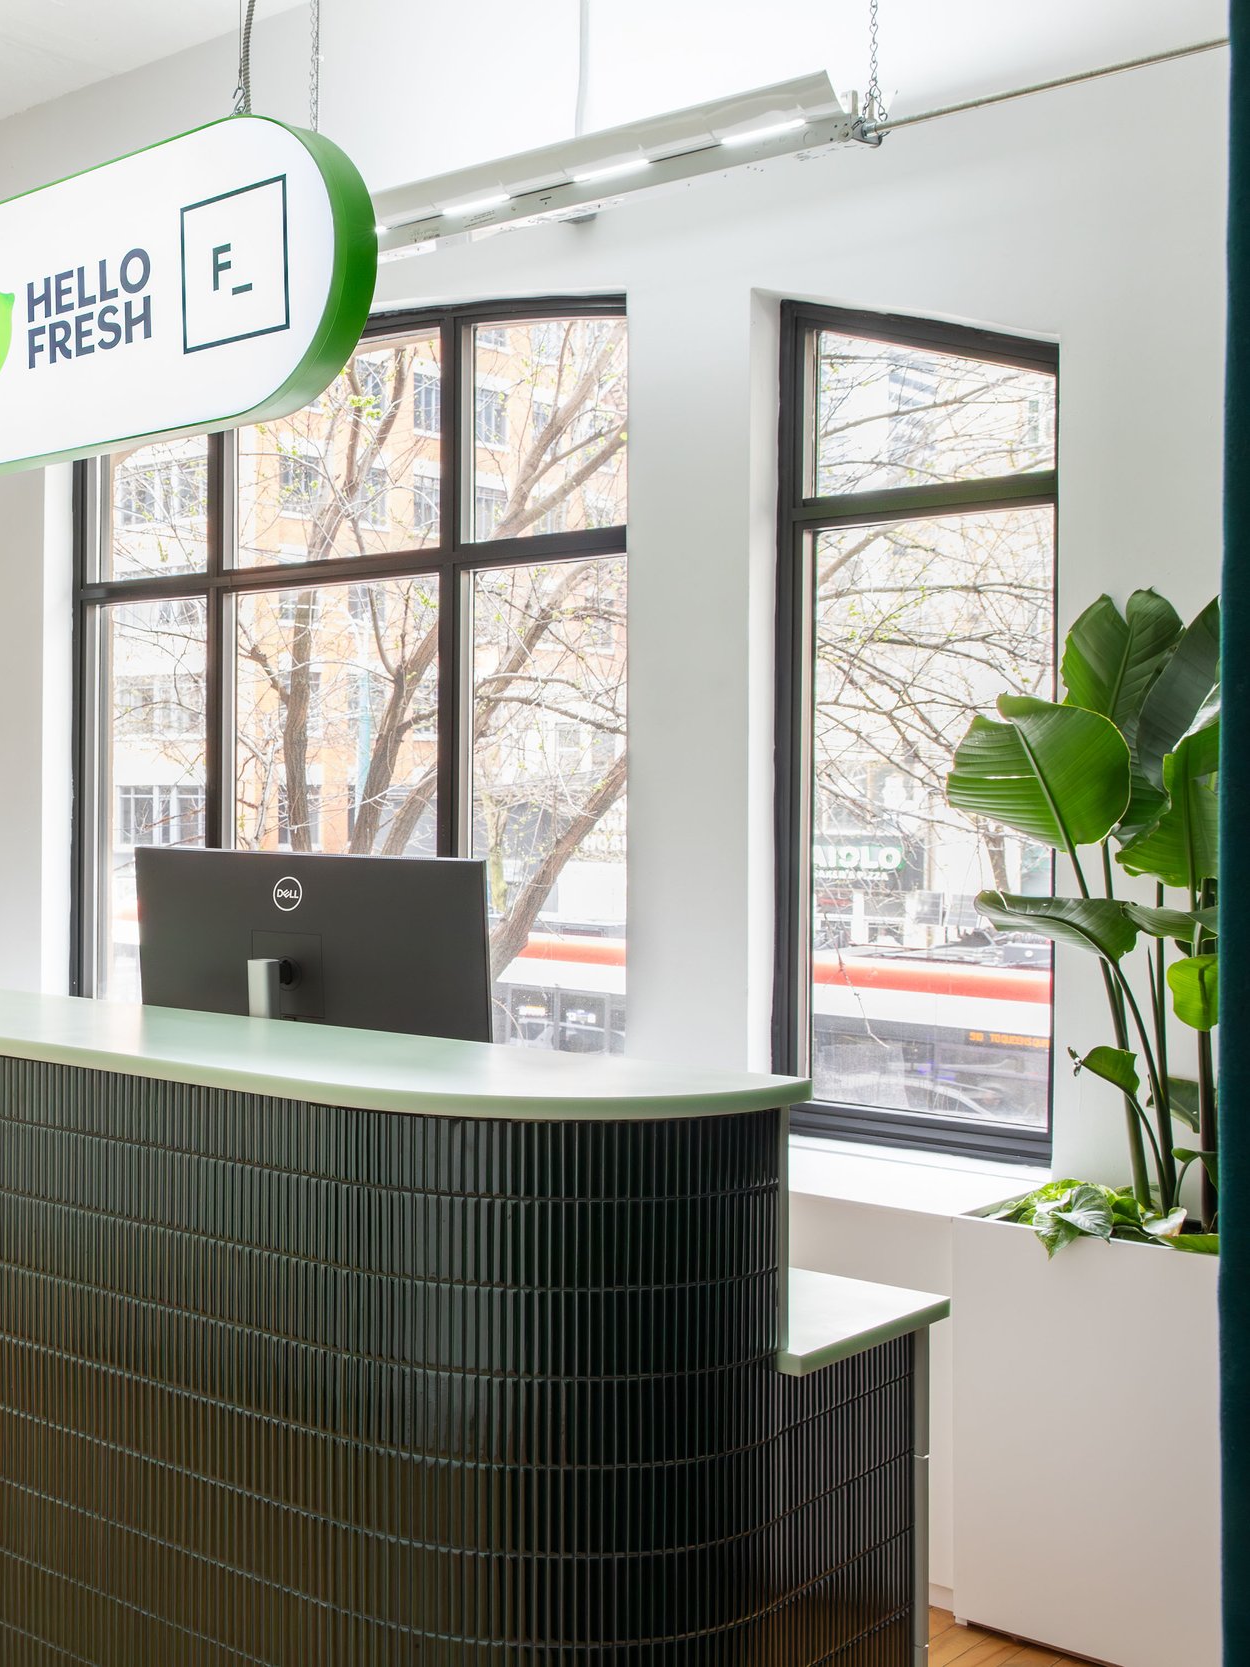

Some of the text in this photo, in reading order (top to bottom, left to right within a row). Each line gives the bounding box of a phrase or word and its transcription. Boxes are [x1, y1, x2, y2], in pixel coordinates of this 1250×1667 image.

[27, 248, 151, 323] HELLO
[28, 295, 152, 370] FRESH
[276, 888, 299, 899] DELL
